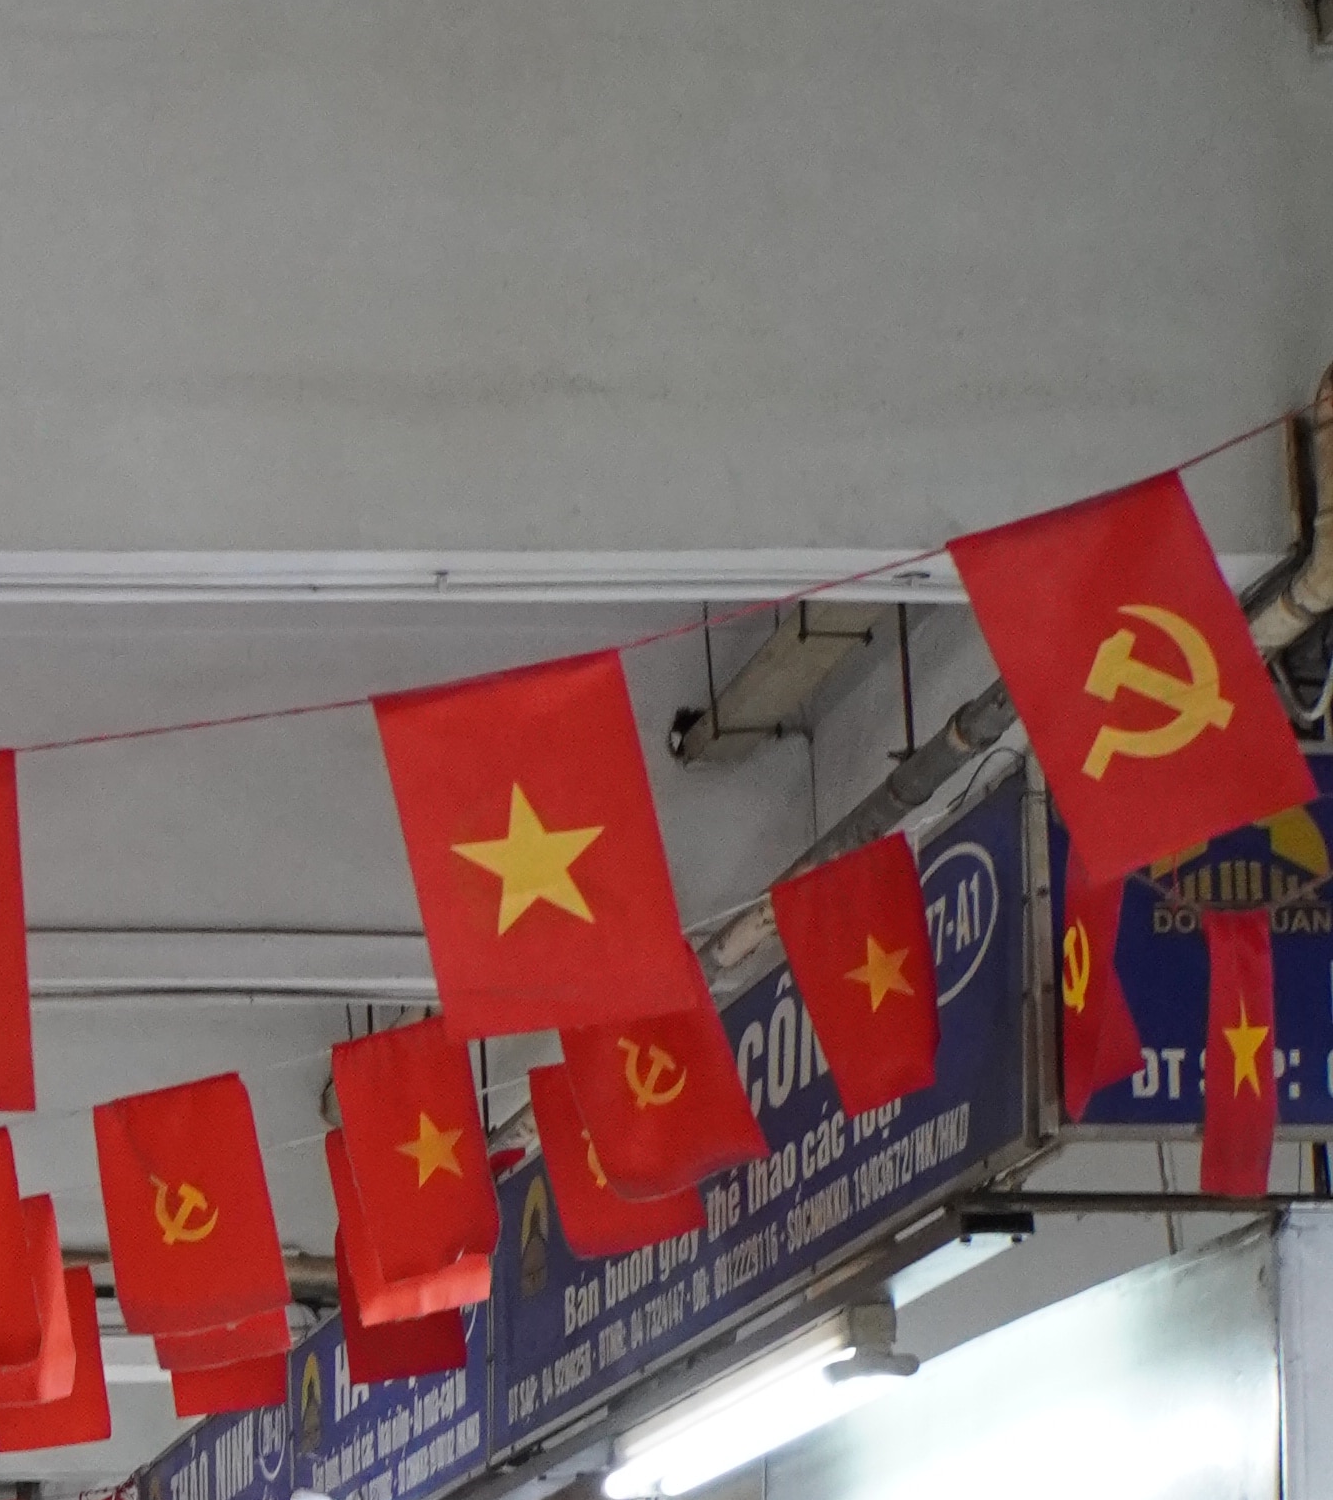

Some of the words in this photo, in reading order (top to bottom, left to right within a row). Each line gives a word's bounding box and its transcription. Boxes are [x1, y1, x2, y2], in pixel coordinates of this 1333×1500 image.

[564, 1268, 600, 1337] Bán
[747, 1152, 796, 1216] thao
[801, 1101, 846, 1180] các
